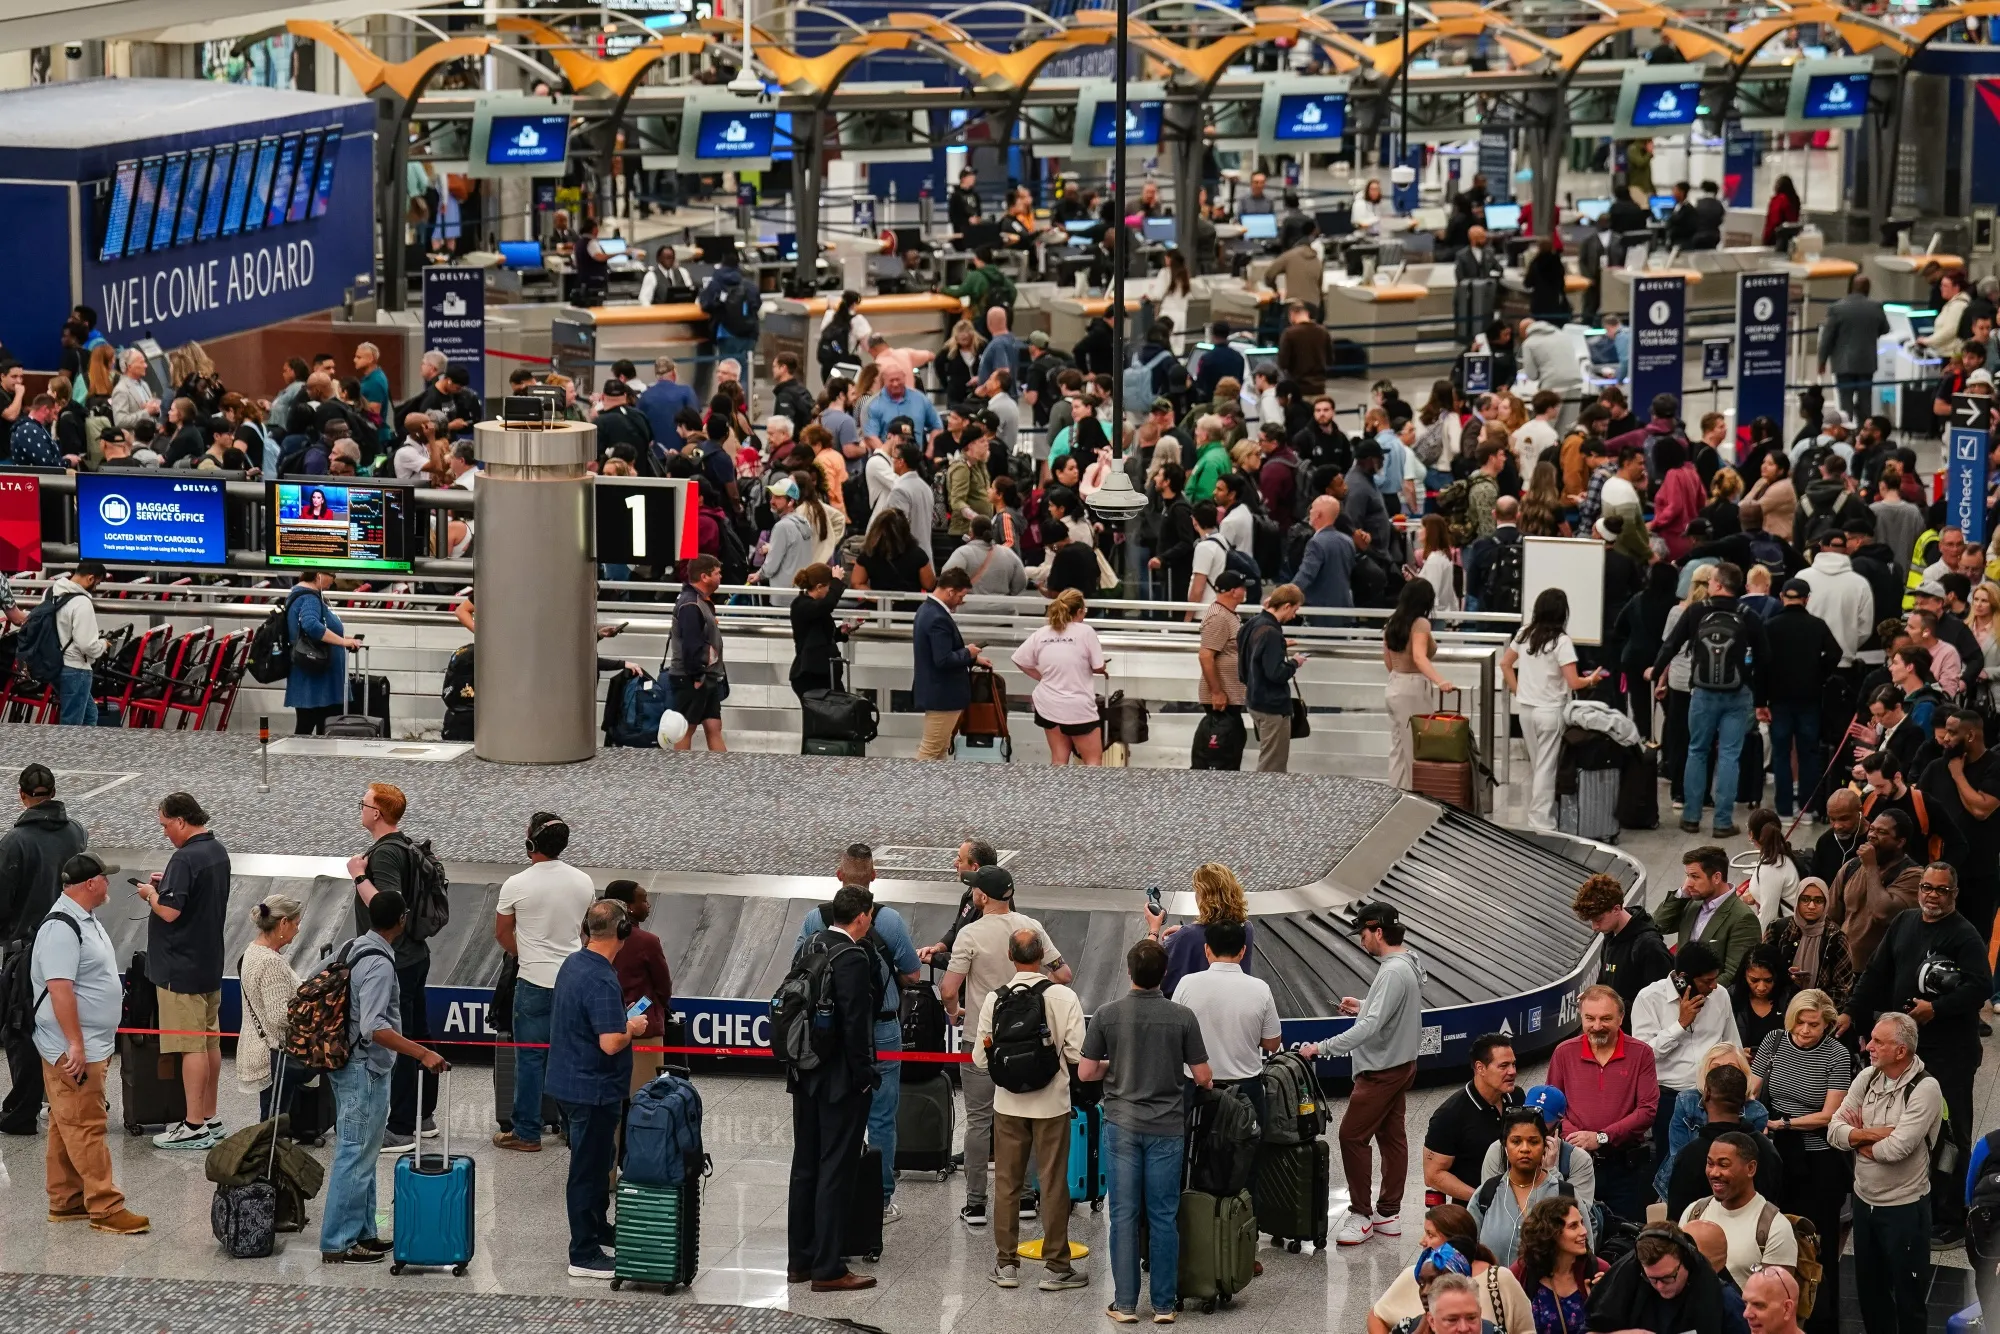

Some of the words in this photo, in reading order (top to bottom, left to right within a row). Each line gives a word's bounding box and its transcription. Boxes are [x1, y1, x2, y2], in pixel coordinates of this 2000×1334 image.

[439, 272, 470, 281] DELTA
[102, 260, 220, 333] WELCOME
[226, 239, 315, 305] ABOARD
[1647, 282, 1674, 290] DELTA
[1759, 302, 1767, 316] 2
[427, 320, 442, 328] APP
[443, 320, 459, 328] BAG
[460, 320, 482, 328] DROP
[182, 484, 210, 492] DELTA
[136, 502, 180, 512] BAGGAGE
[136, 512, 172, 521] SERVICE
[174, 513, 204, 522] OFFICE
[625, 494, 646, 557] 1
[104, 533, 134, 541] LOCATED
[135, 534, 152, 542] NEXT
[692, 1012, 771, 1047] CHEC
[1443, 1034, 1455, 1042] LEARN
[1456, 1032, 1467, 1040] MORE
